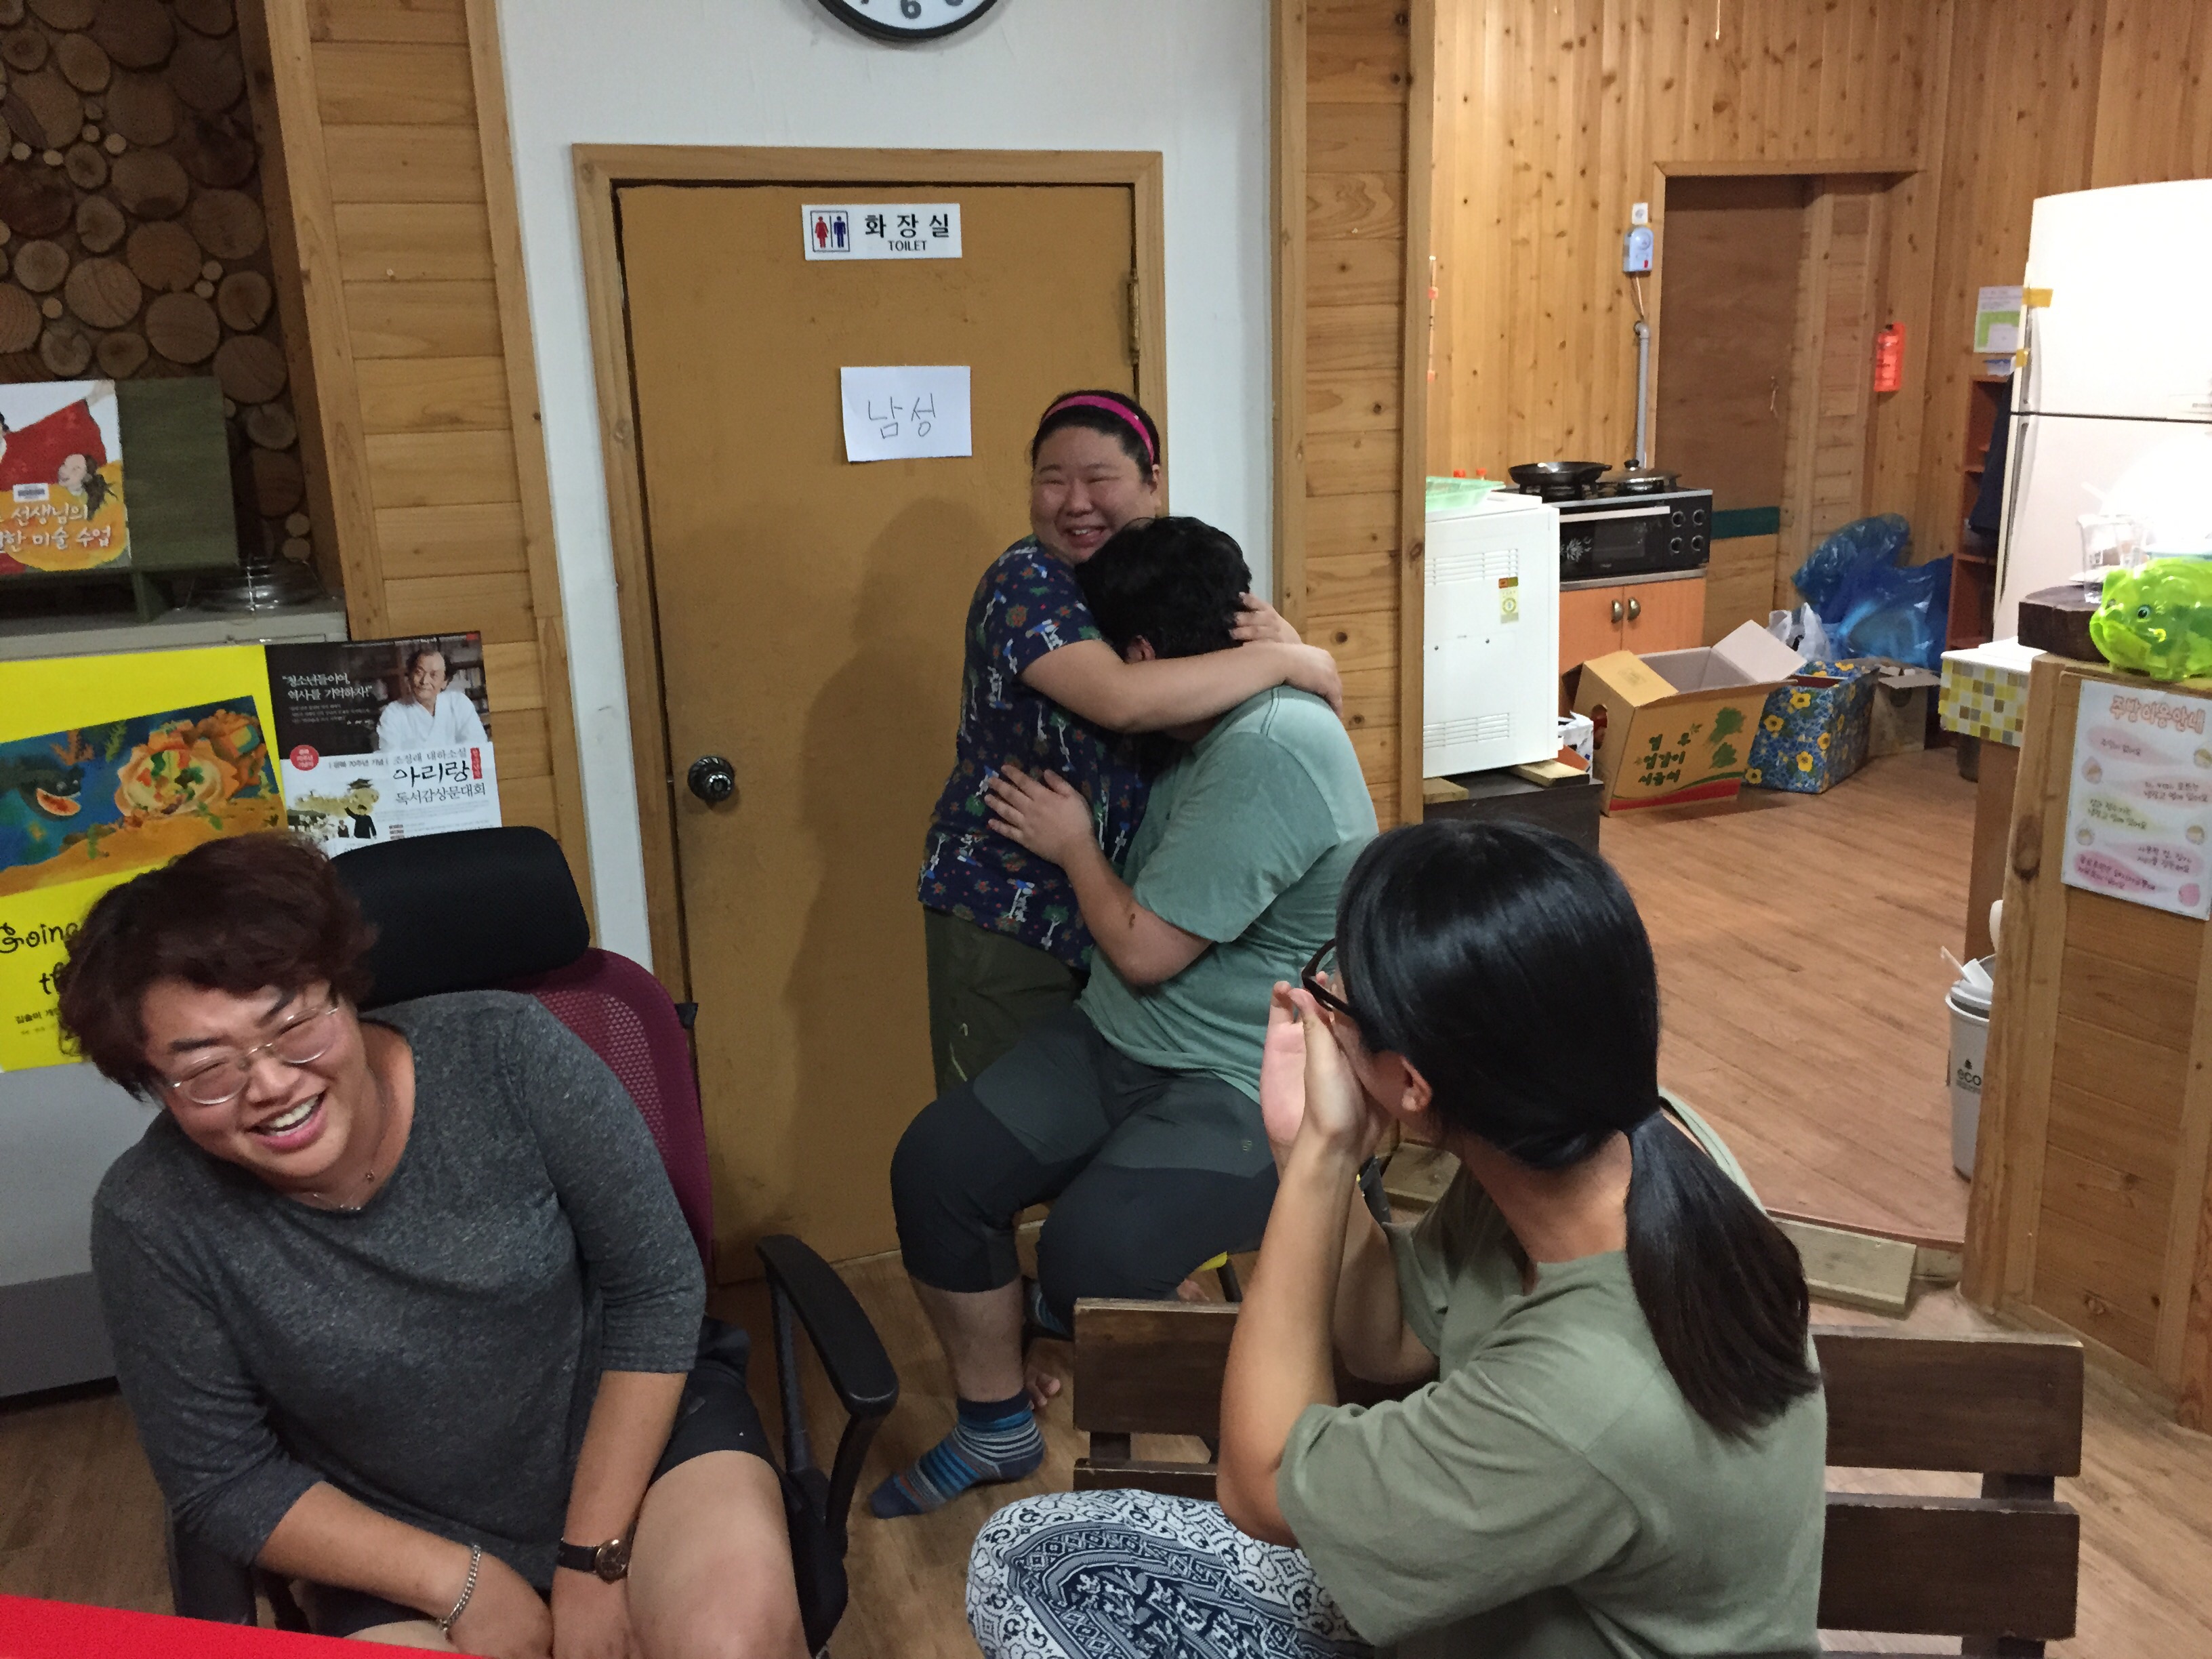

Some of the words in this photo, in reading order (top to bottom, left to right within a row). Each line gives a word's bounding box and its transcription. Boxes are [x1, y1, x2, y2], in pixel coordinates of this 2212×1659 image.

[865, 213, 949, 238] 화장실
[888, 240, 927, 251] TOILET
[868, 393, 936, 439] 남성
[12, 502, 88, 527] 선생님의
[0, 529, 26, 553] 한
[33, 527, 68, 550] 미술
[76, 525, 111, 548] 수업
[393, 760, 470, 787] 아리랑
[396, 782, 486, 805] 독서감상문대회
[1957, 1069, 1982, 1086] eco
